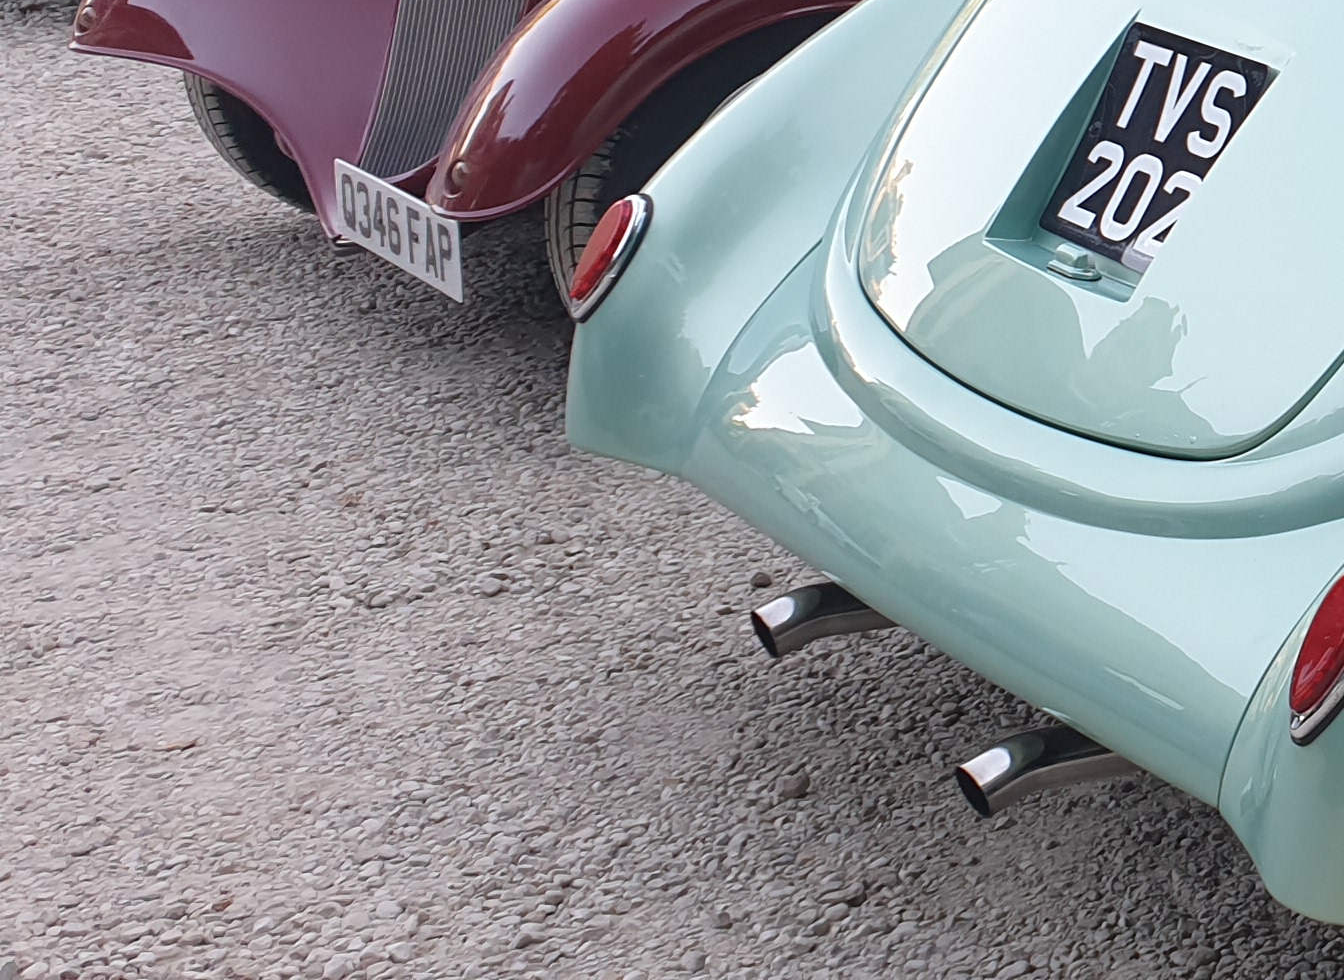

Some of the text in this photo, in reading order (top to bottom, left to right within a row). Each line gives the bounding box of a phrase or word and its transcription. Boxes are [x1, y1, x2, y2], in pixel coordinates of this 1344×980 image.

[1115, 38, 1248, 159] TVS
[341, 173, 453, 282] Q346 FAP
[1056, 139, 1203, 259] 202
